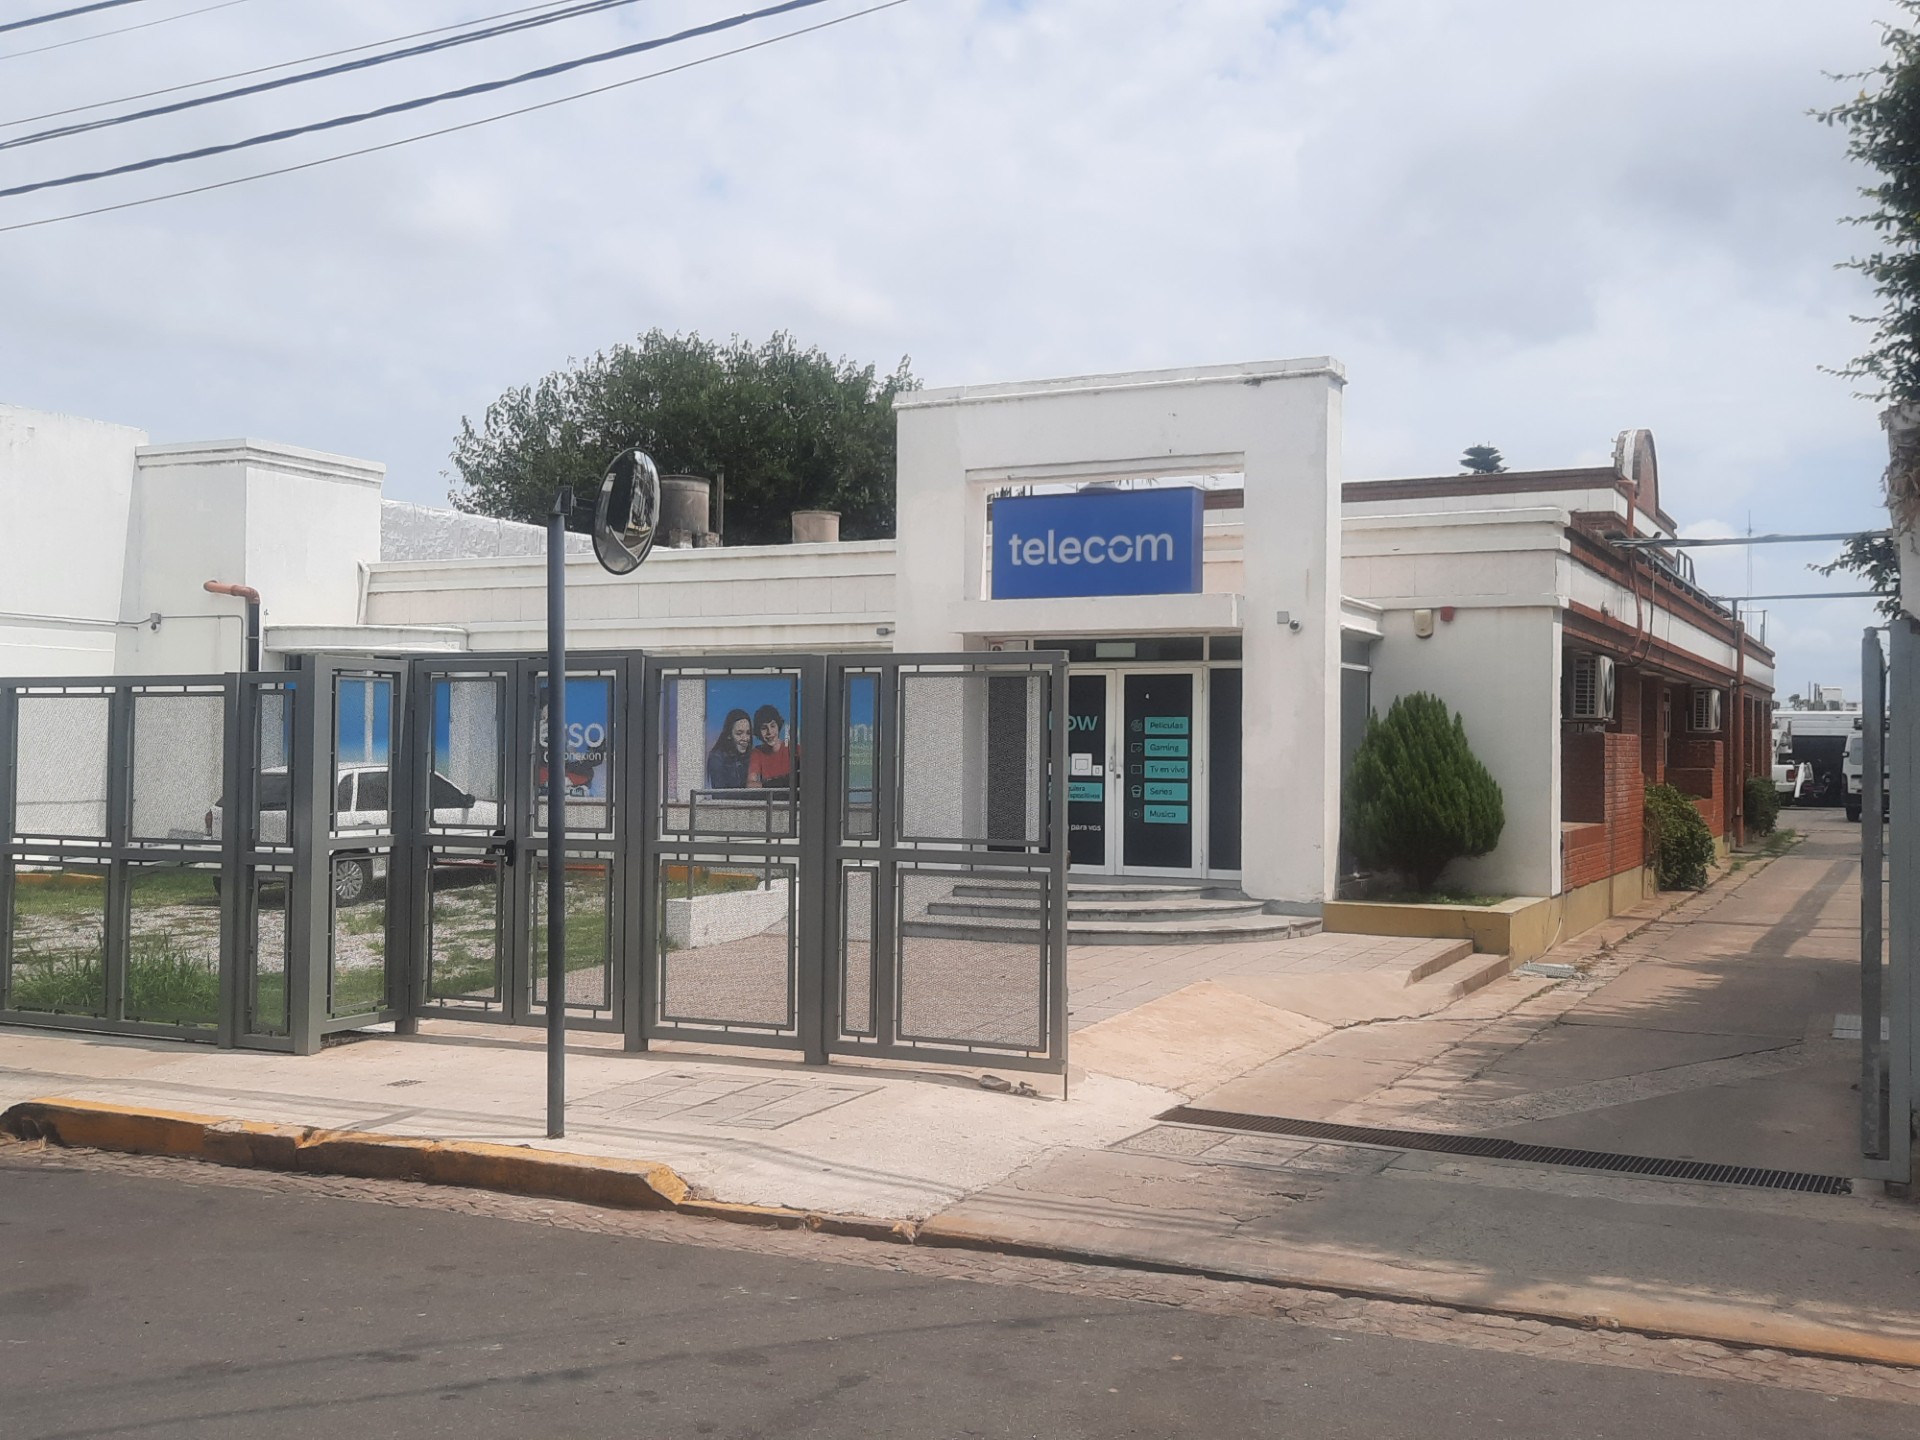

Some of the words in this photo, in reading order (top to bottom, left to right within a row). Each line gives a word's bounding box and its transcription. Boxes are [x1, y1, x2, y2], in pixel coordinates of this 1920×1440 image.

[1008, 529, 1174, 566] telecom
[1149, 743, 1179, 752] Gaming
[1170, 764, 1185, 774] vivo
[1149, 787, 1173, 796] Series
